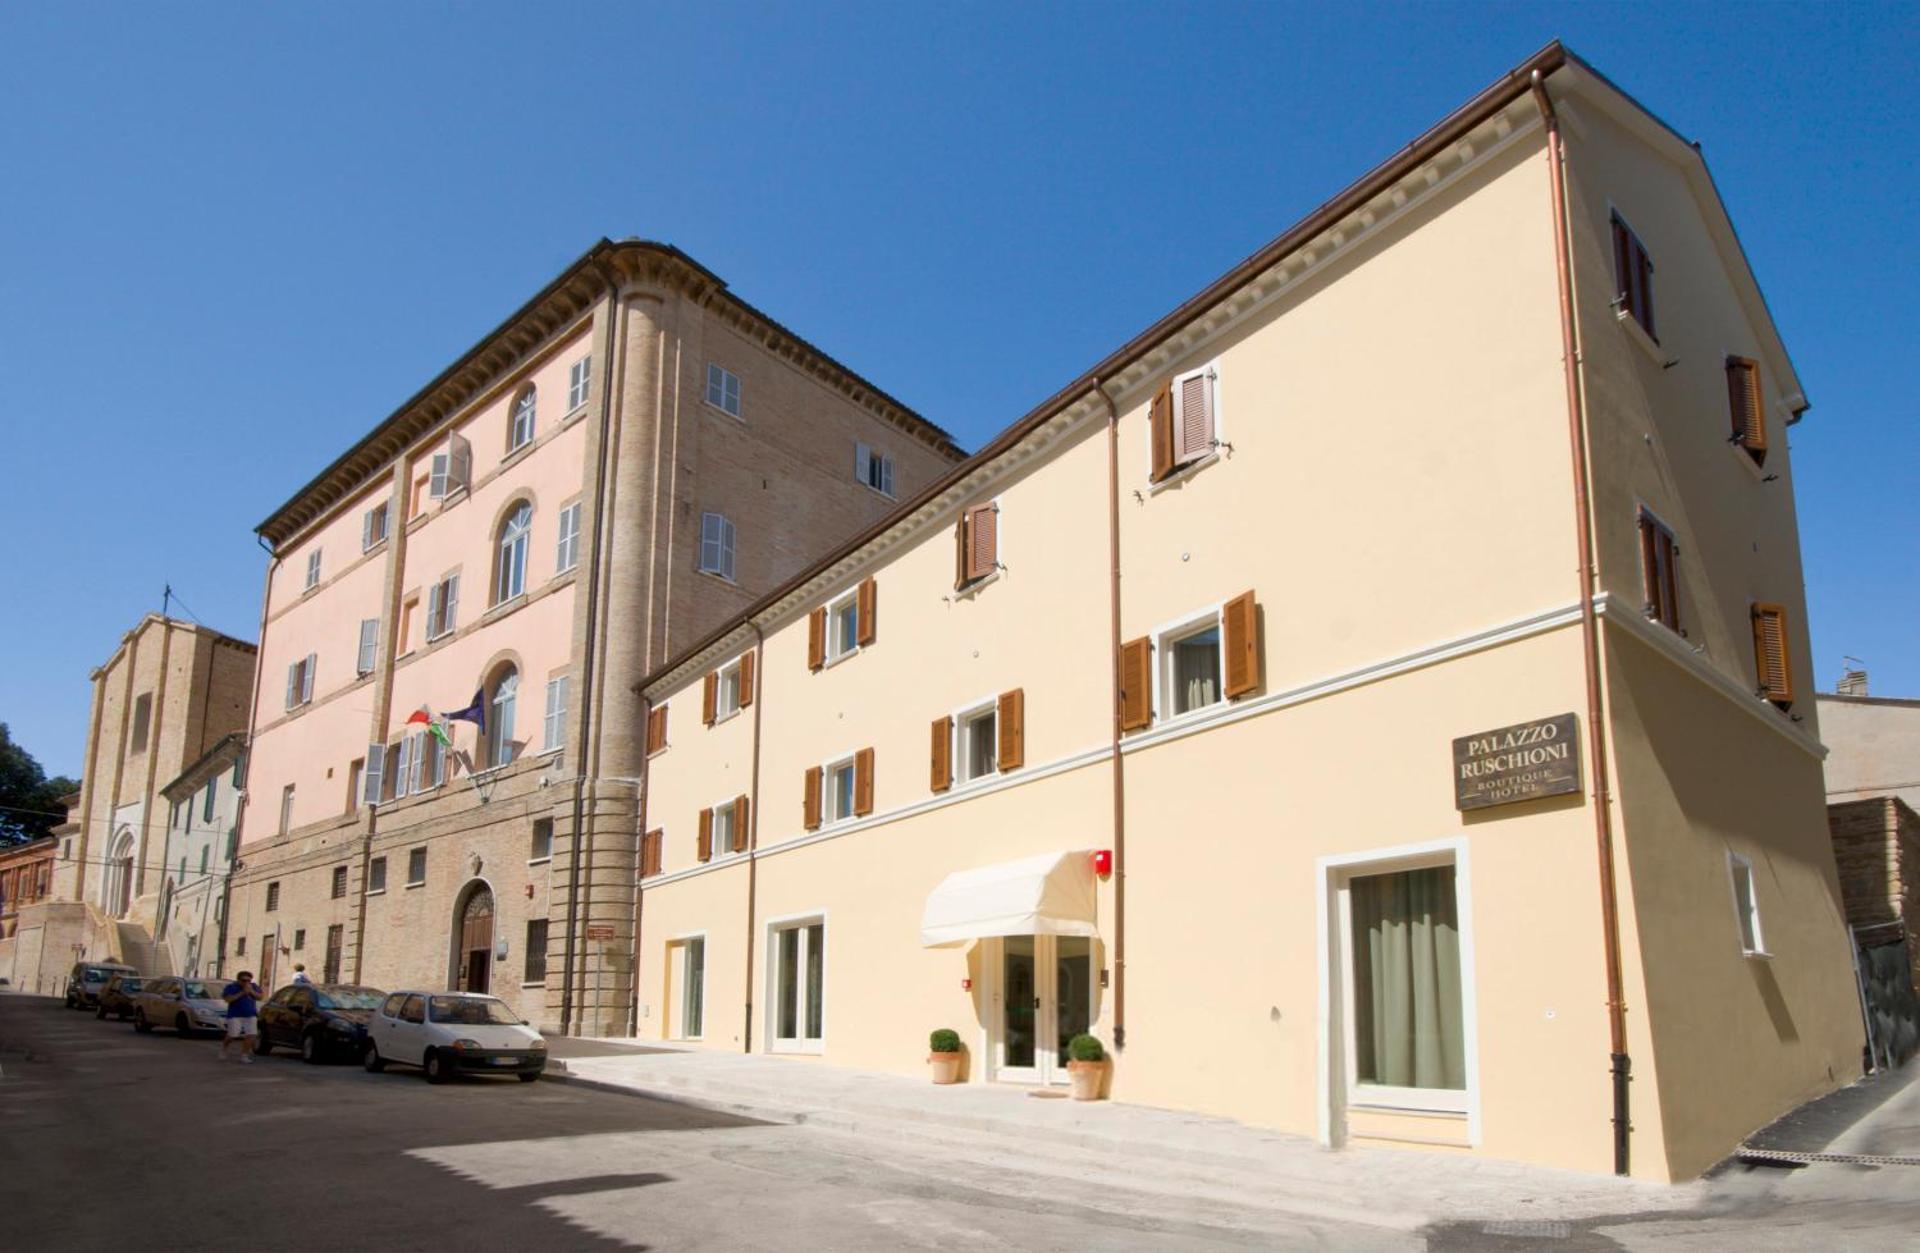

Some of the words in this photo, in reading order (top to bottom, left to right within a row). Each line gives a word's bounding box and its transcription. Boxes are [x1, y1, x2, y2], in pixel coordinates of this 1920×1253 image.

[1468, 723, 1557, 756] PALAZZO
[1460, 742, 1568, 779] RUSCHIONI
[1477, 769, 1552, 790] BOUTIQUE
[1491, 784, 1537, 799] HOTEL
